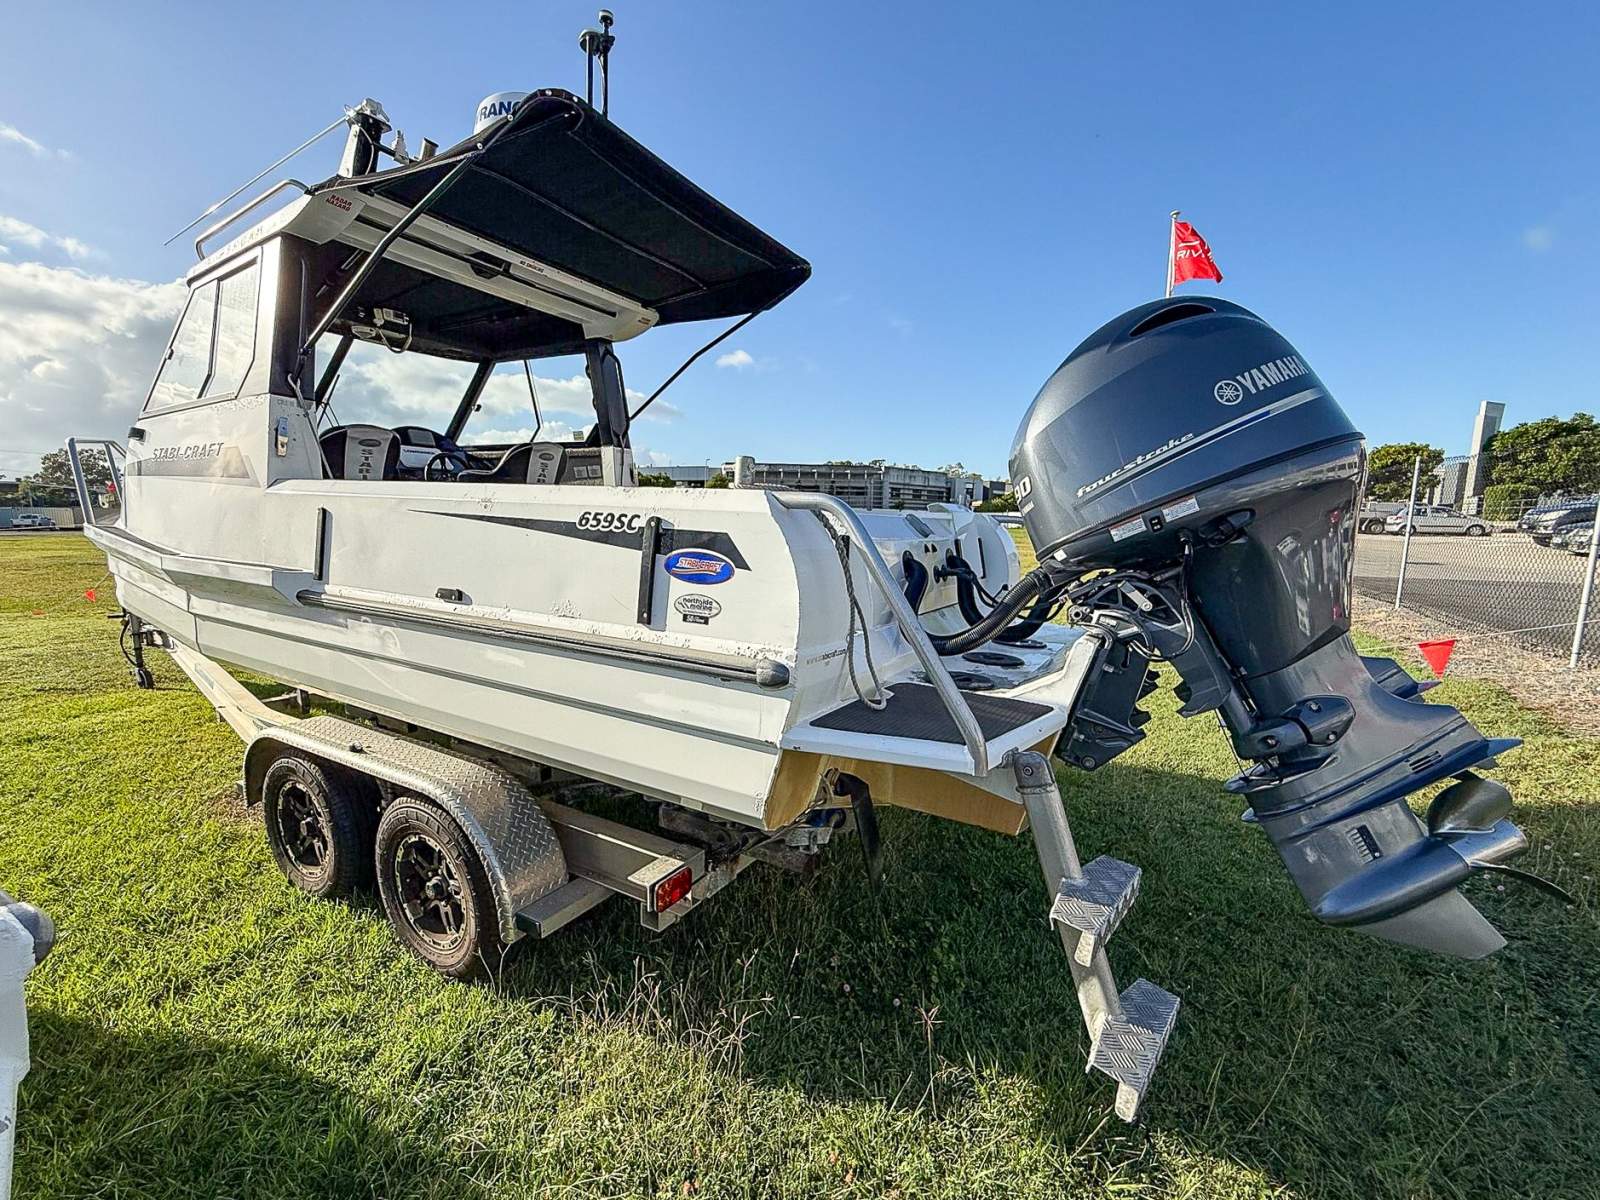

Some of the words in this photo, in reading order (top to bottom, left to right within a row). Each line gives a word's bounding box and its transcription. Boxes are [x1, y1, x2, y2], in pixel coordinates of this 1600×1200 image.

[1236, 355, 1309, 395] YAMAHA
[1075, 468, 1125, 498] four
[1122, 432, 1195, 469] stroke
[577, 511, 641, 532] 659SC
